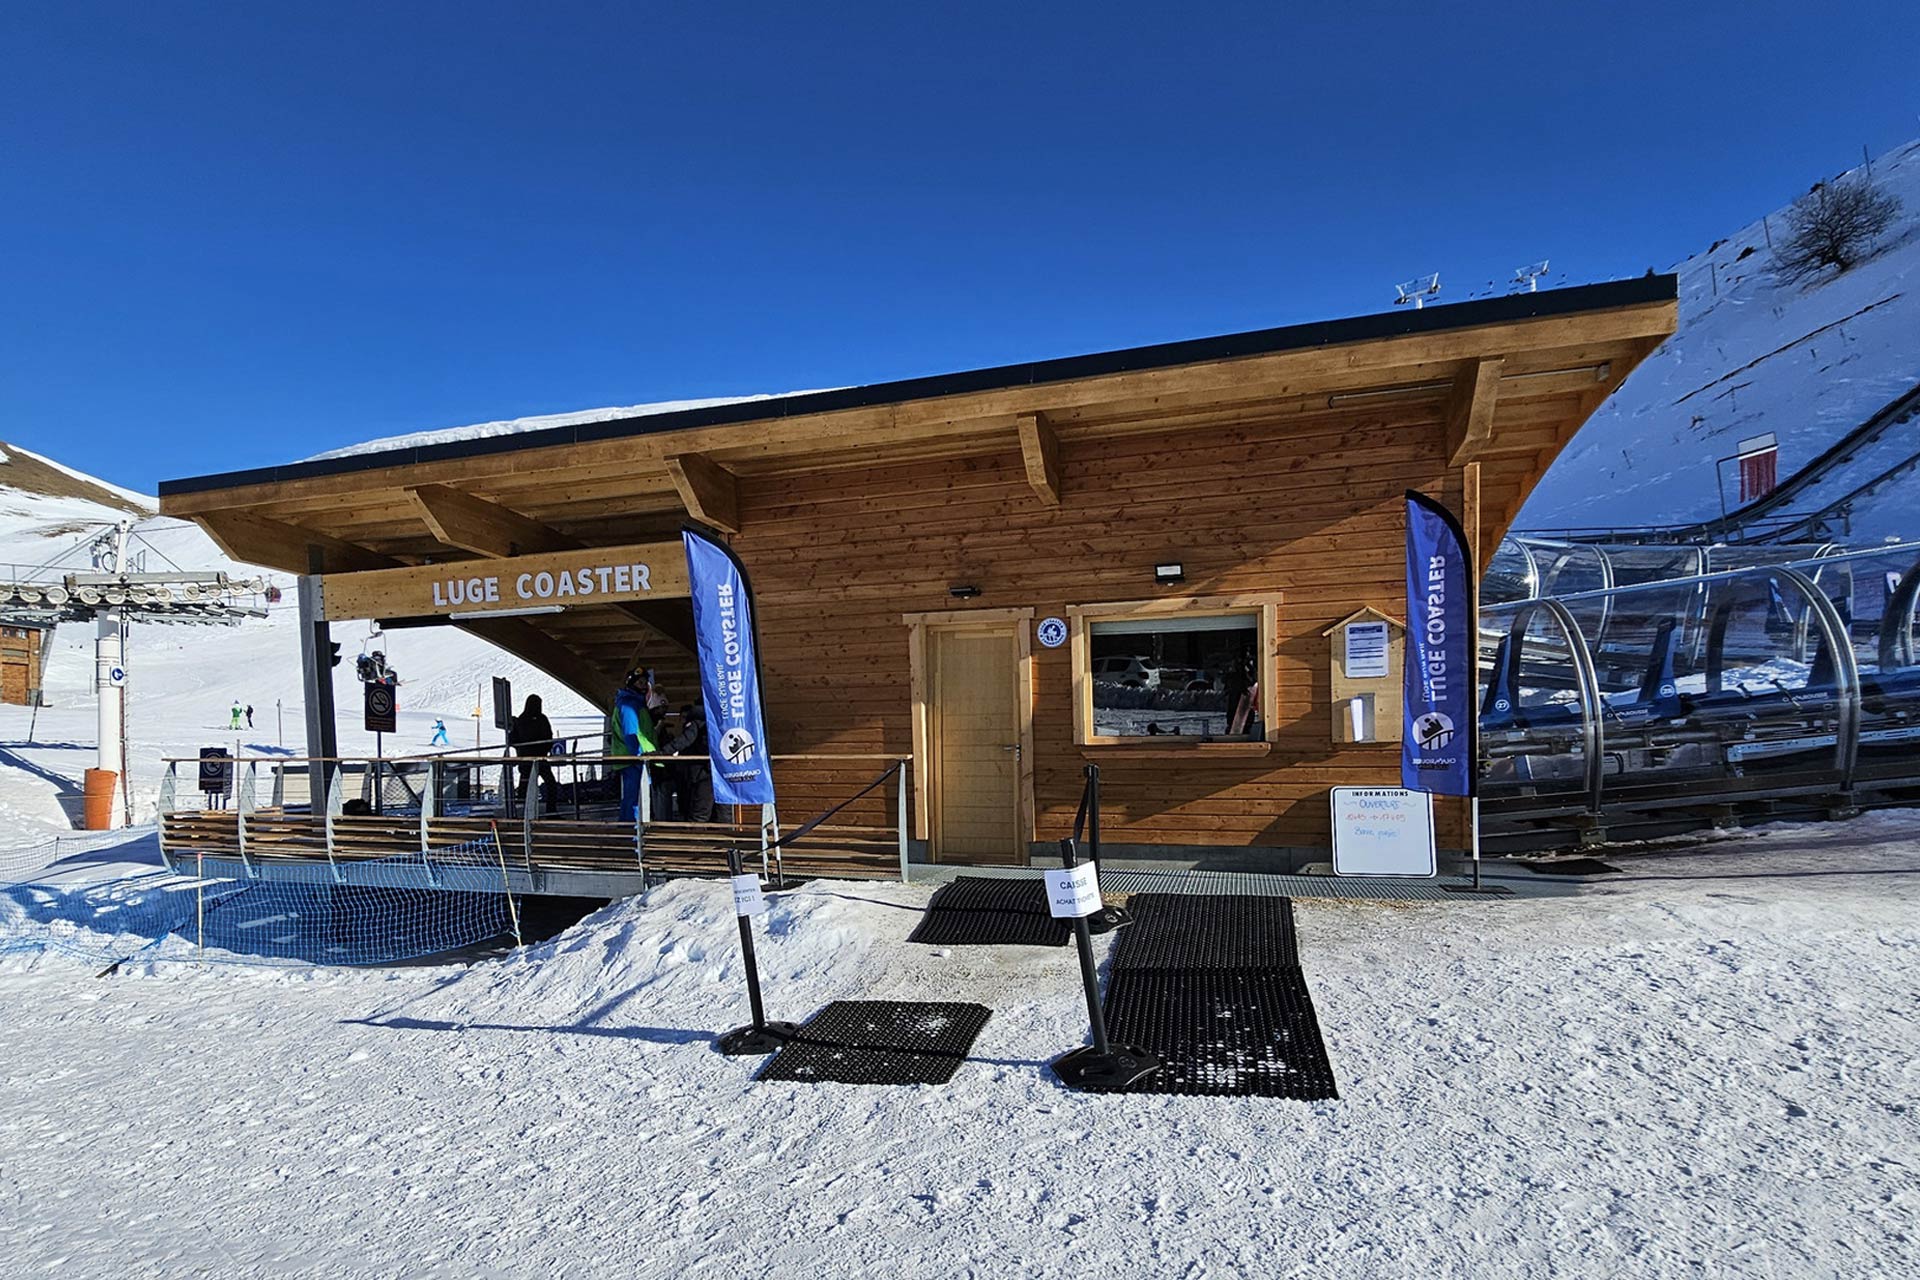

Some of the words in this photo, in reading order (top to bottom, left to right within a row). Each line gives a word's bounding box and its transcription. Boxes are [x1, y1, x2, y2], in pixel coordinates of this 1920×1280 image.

[433, 577, 500, 606] LUGE
[516, 564, 651, 599] COASTER
[1059, 877, 1087, 890] CAISSE
